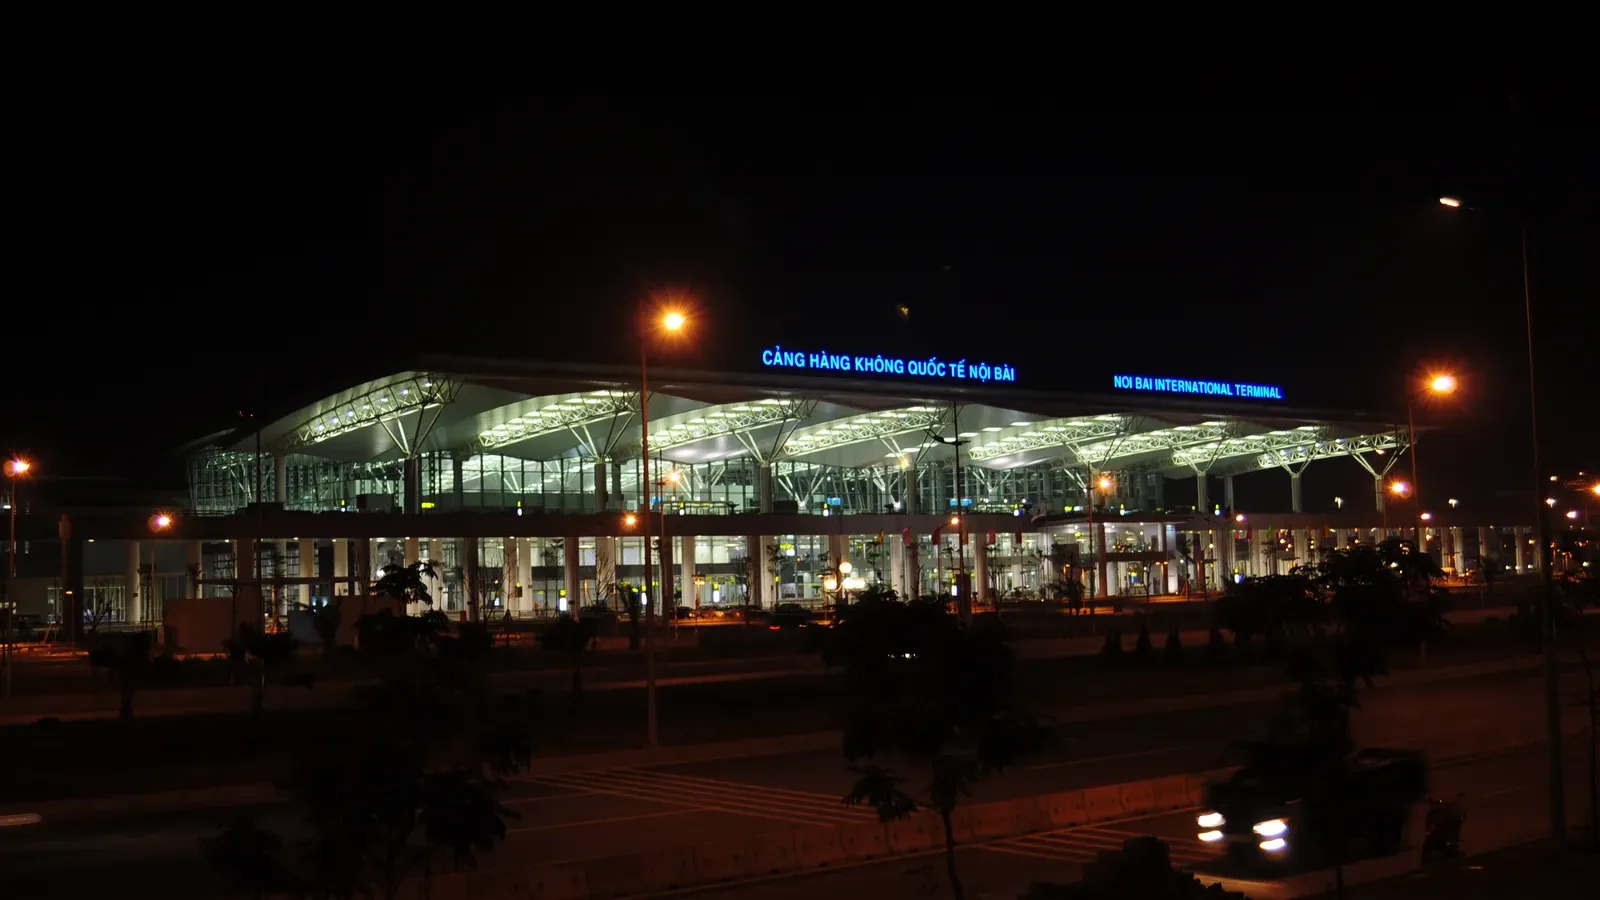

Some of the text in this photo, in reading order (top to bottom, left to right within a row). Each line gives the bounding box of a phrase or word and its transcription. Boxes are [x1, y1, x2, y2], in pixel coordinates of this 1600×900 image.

[762, 345, 1016, 382] CẢNG HÀNG KHÔNG QUỐC TẾ NỘI BÀI
[1114, 375, 1282, 399] NOI BAI INTERNATIONAL TERMINAL
